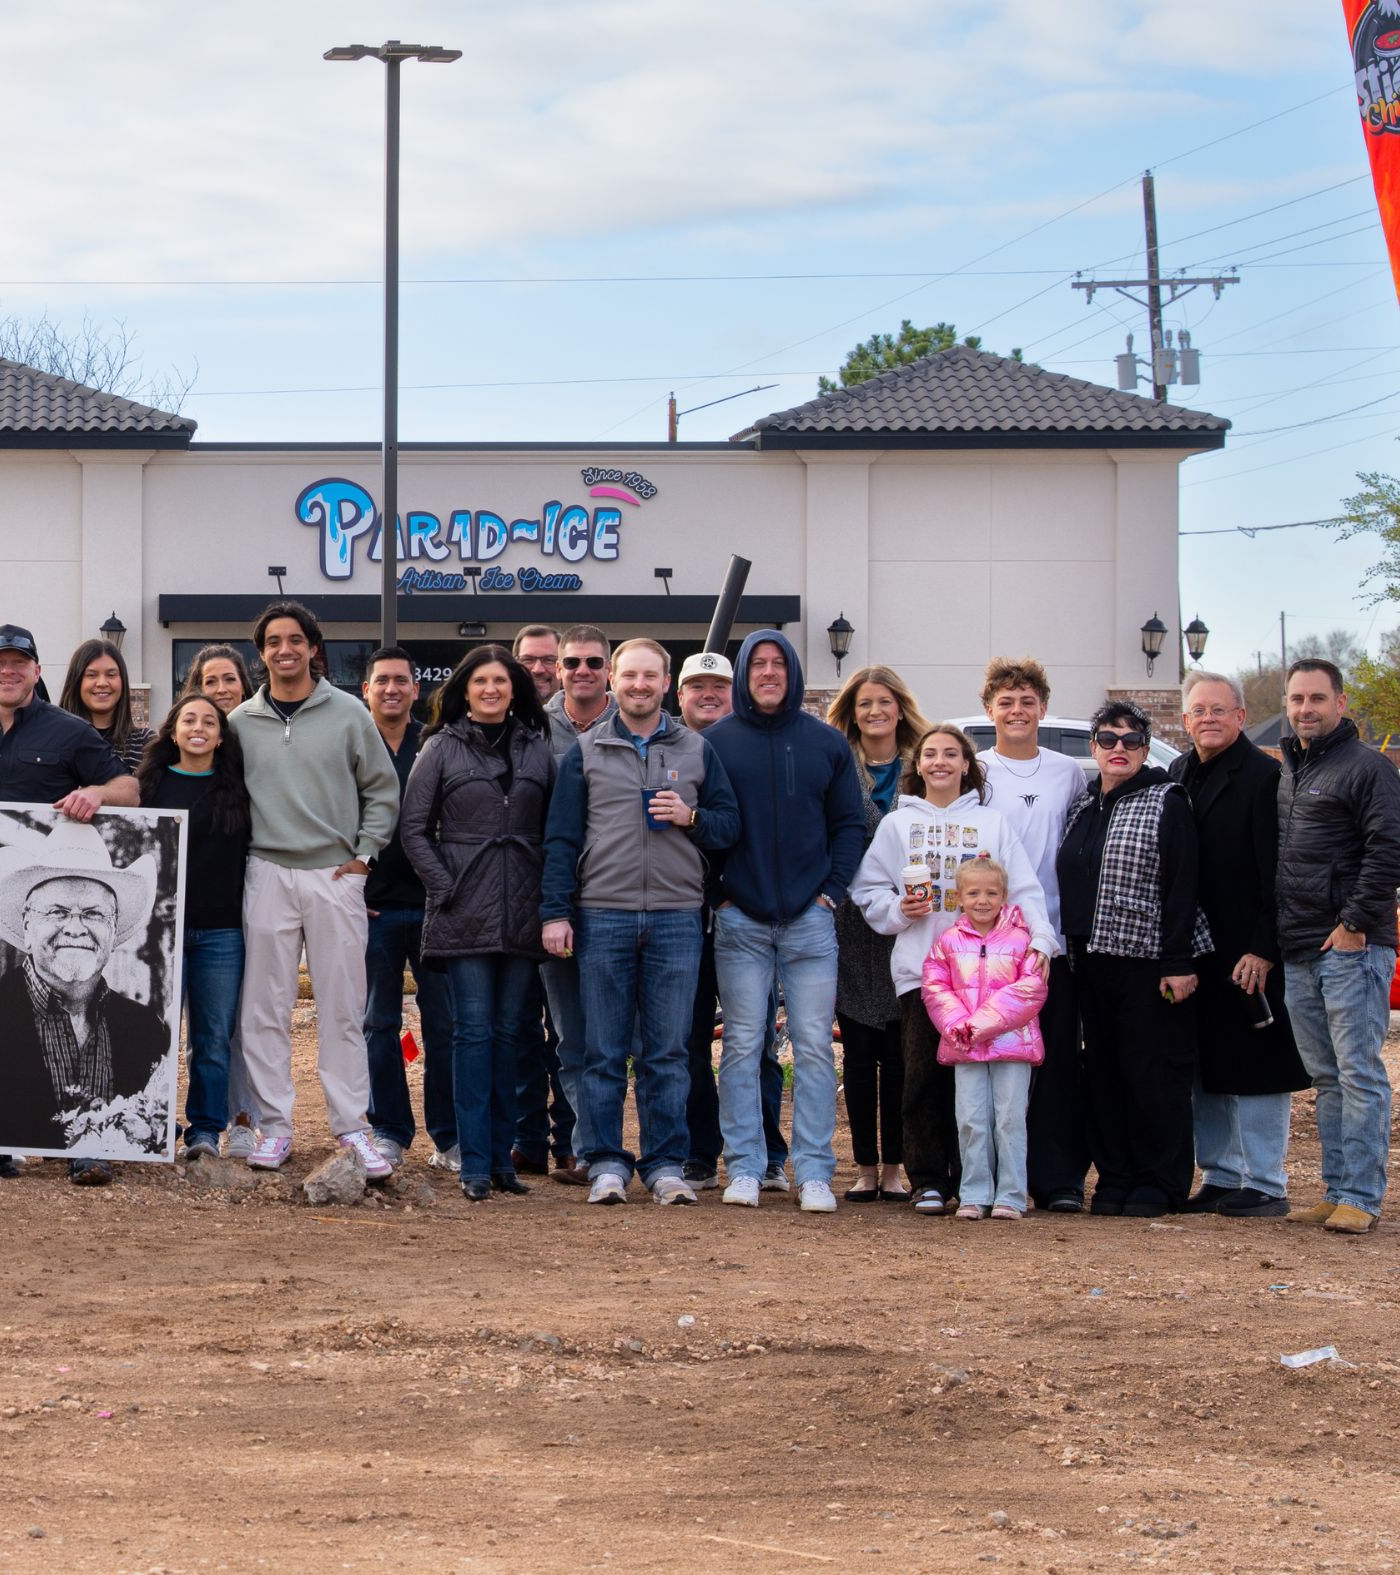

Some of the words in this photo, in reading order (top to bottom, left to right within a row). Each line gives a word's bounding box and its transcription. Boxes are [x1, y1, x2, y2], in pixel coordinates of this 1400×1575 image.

[1367, 92, 1400, 132] Chi
[581, 467, 623, 486] Since
[623, 472, 658, 499] 1958
[396, 566, 467, 596] Artisan
[479, 566, 515, 592] Ice
[517, 567, 583, 593] Cream
[415, 667, 452, 681] 3429
